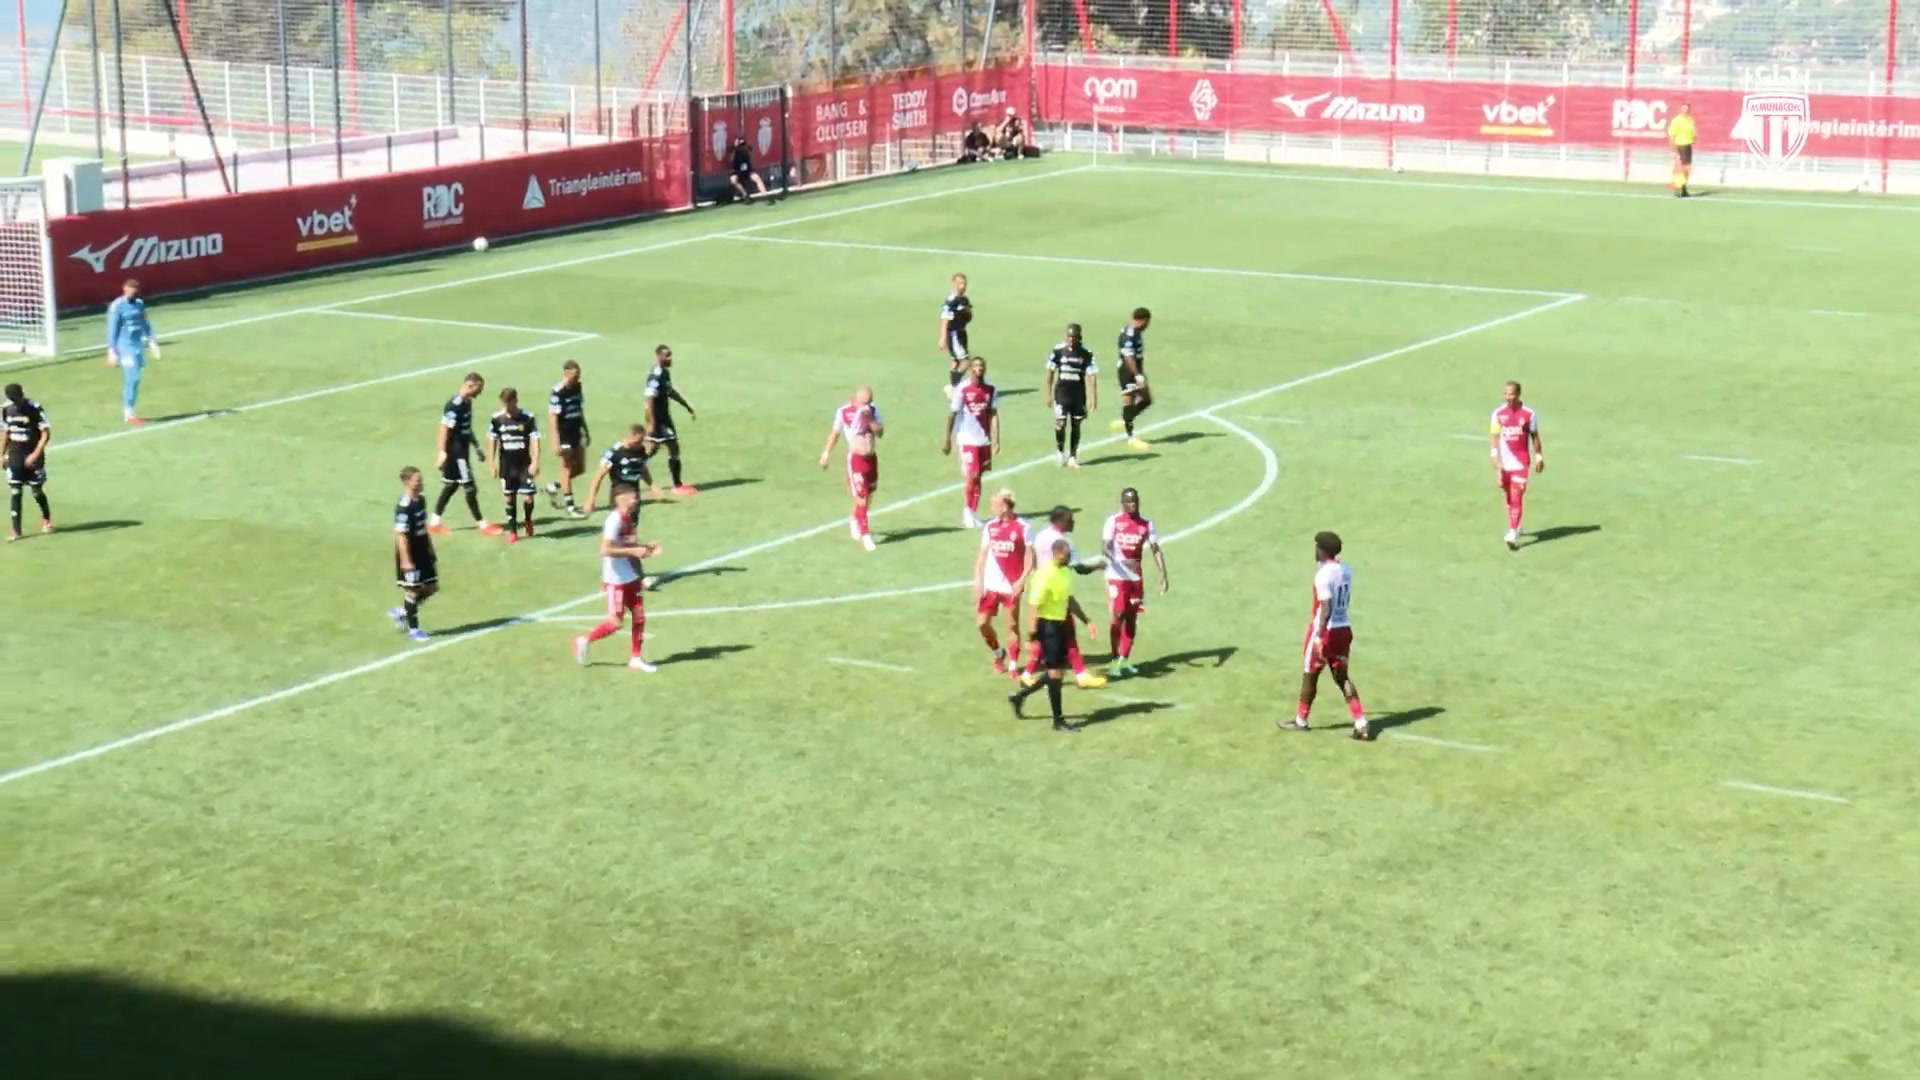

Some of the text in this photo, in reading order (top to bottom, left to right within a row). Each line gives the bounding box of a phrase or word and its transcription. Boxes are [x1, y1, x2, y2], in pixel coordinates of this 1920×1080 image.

[815, 99, 867, 121] BANG &
[892, 90, 928, 110] TEDDY
[892, 109, 928, 129] SMITH
[1482, 101, 1548, 124] vbet
[815, 119, 867, 143] OLUFSEN
[296, 206, 353, 236] vbet
